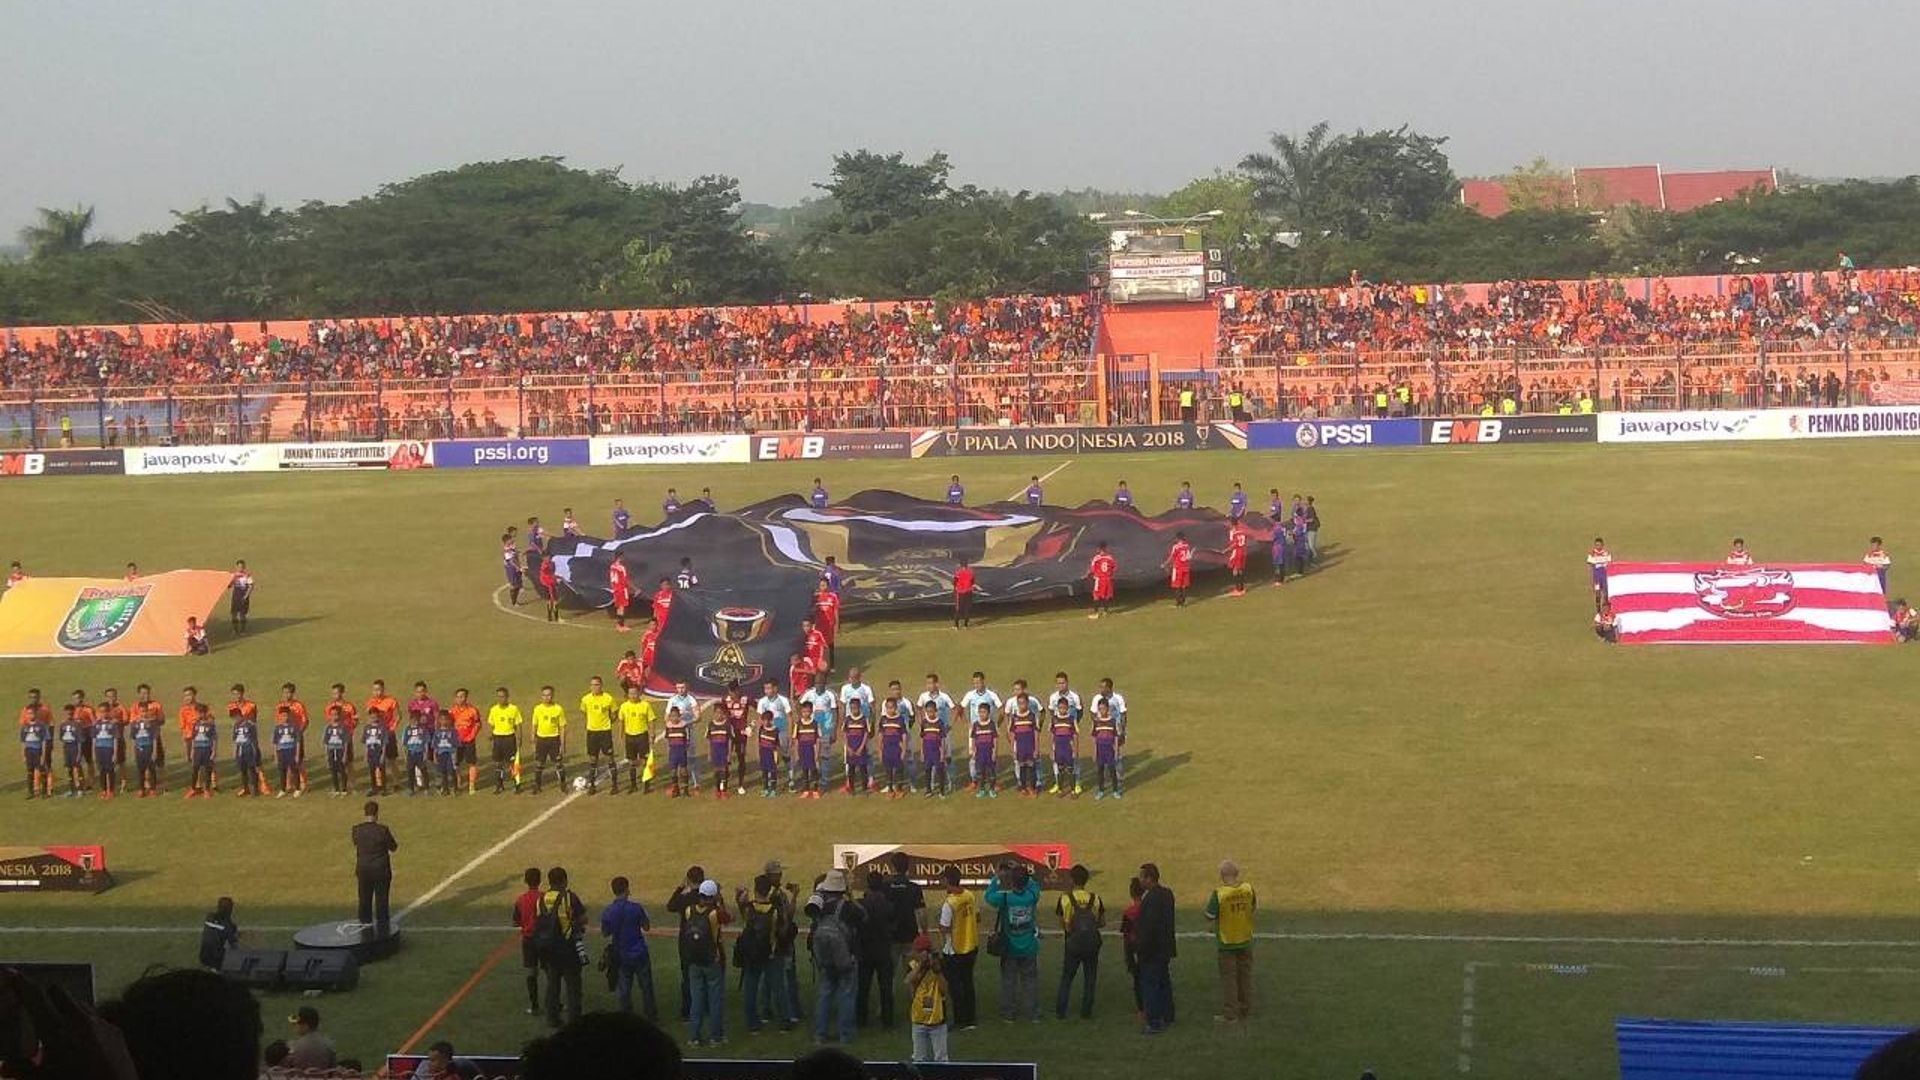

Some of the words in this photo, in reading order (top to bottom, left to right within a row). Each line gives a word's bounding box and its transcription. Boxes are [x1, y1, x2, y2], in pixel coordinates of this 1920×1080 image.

[1430, 421, 1502, 444] EMB
[1808, 413, 1860, 433] PEMKAB
[965, 435, 1018, 450] PIALA
[1142, 431, 1185, 446] 2018
[1321, 424, 1372, 445] PSSI
[474, 444, 549, 464] pssi.org
[606, 441, 695, 460] jawapostv
[759, 437, 825, 460] EMB
[0, 454, 45, 475] MB
[143, 452, 226, 469] jawapostv
[42, 863, 72, 876] 2018
